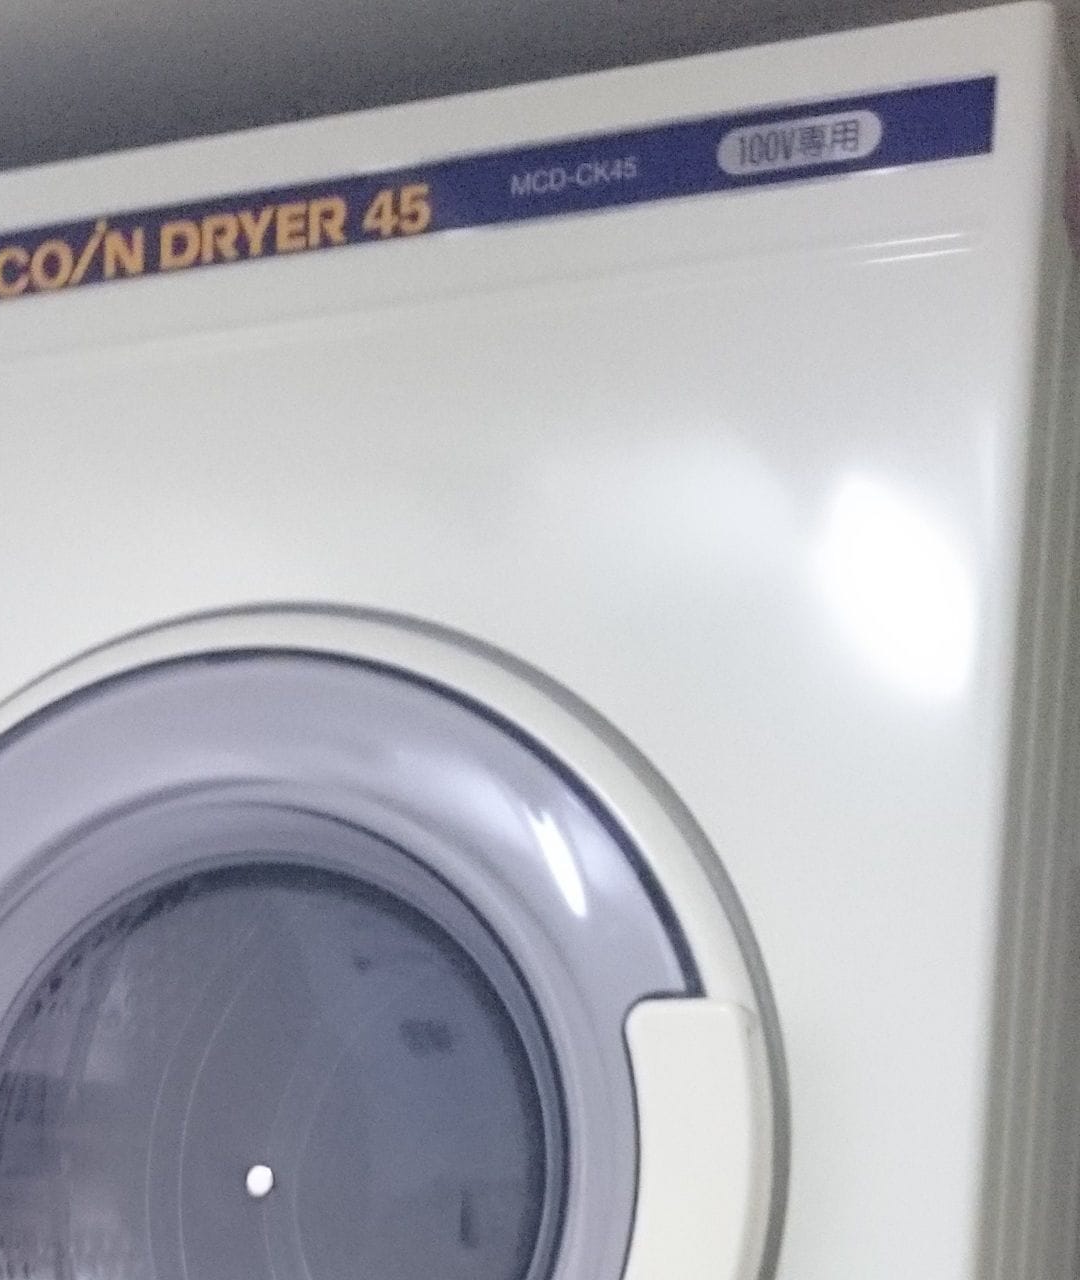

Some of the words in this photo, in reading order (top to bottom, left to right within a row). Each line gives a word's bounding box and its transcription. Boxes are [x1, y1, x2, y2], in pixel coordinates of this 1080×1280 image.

[738, 119, 861, 168] 100V専用
[510, 156, 639, 198] MCD-CK45
[159, 197, 347, 270] DRYER
[363, 184, 432, 237] 45
